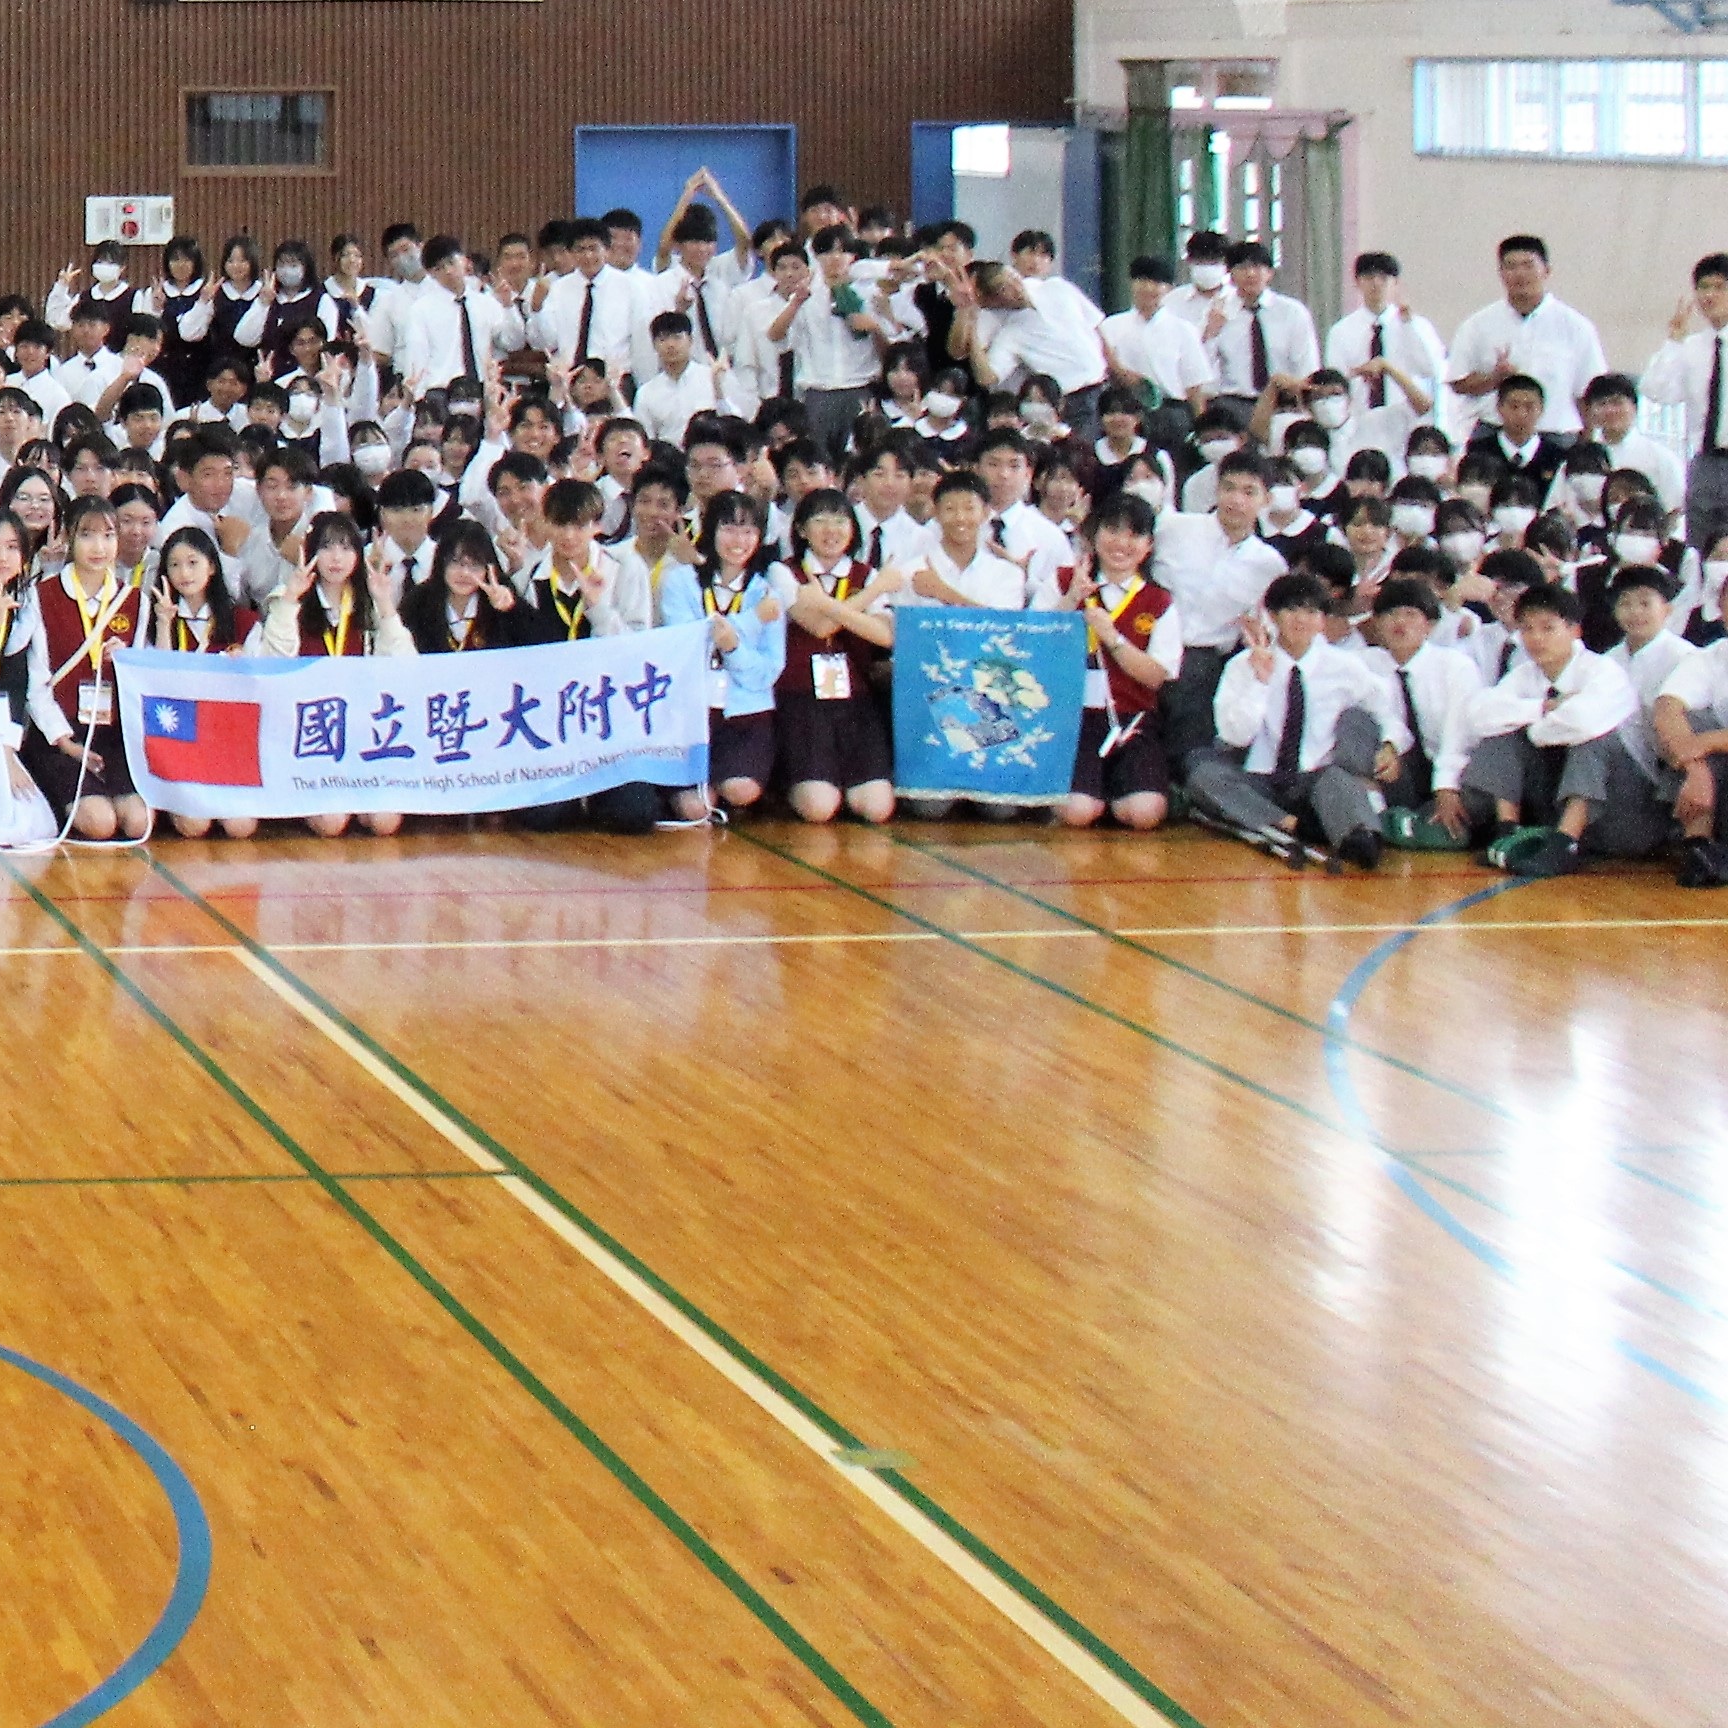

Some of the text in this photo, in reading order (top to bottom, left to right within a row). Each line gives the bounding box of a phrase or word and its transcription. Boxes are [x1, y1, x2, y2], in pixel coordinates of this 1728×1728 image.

[292, 662, 673, 763] 國立暨大附中
[292, 776, 317, 791] The
[320, 775, 380, 790] Affiliated
[423, 774, 455, 793] High
[457, 770, 502, 788] School
[504, 768, 517, 784] of
[520, 764, 575, 784] National
